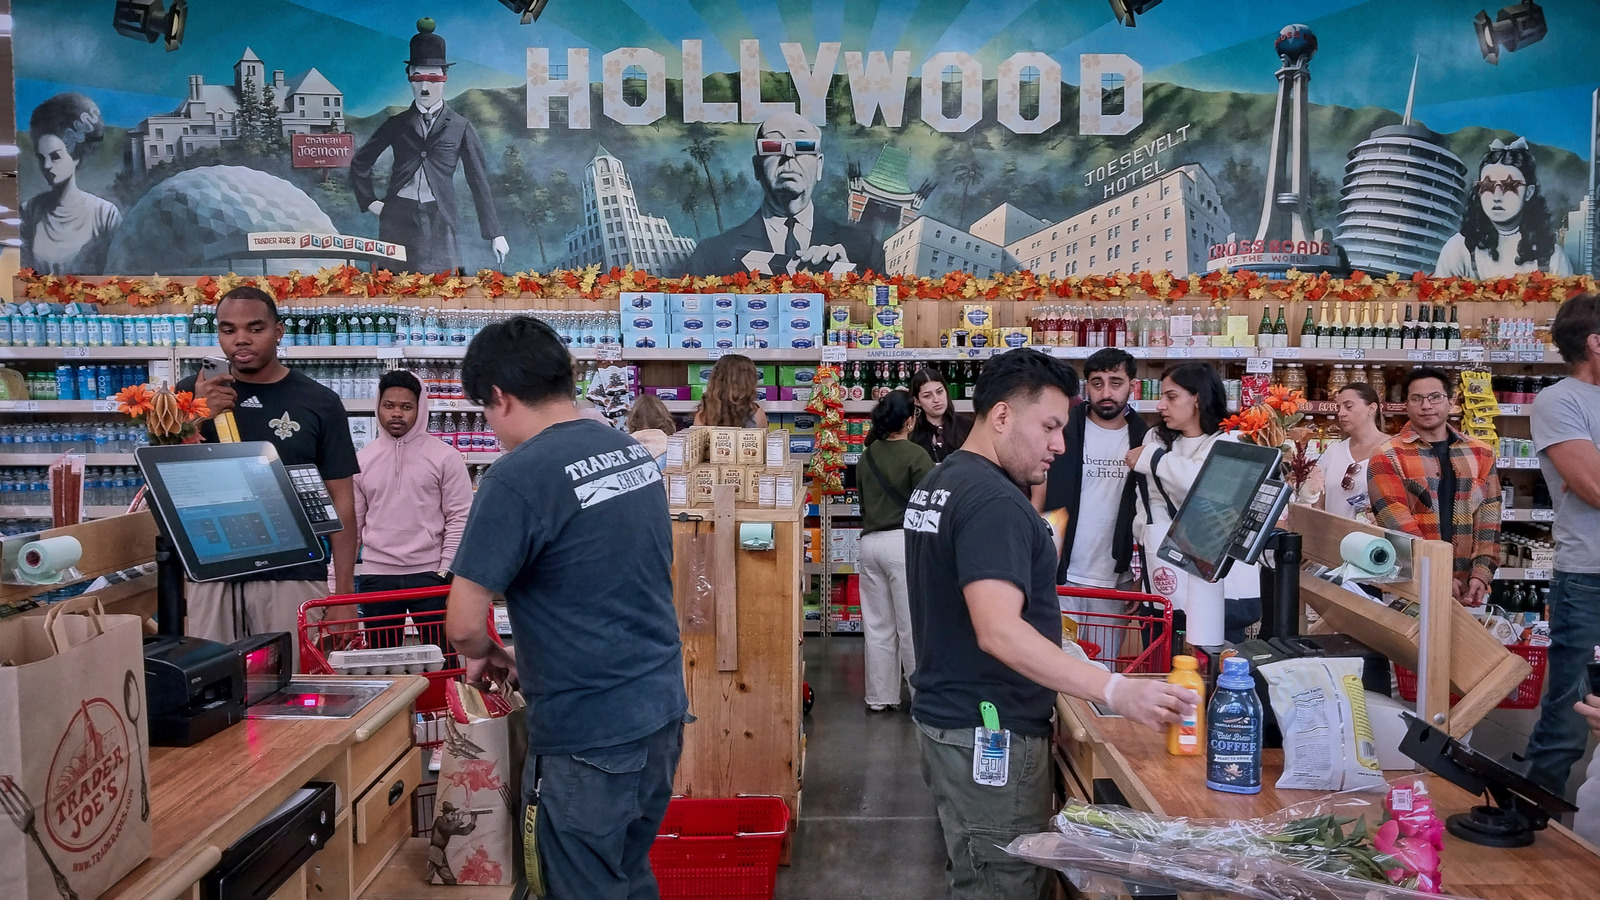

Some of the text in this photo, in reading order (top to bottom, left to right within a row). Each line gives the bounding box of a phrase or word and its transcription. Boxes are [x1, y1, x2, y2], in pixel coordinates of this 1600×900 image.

[526, 40, 1144, 136] HOLLYWOOD
[1084, 124, 1190, 186] JOESEVELT
[1103, 160, 1166, 199] HOTEL
[278, 236, 296, 244] JOE'S
[1208, 240, 1330, 260] CROSS ROADS
[98, 376, 106, 394] ZICO
[564, 449, 630, 480] TRADER
[1083, 454, 1125, 466] bercrom
[616, 468, 648, 490] CREW
[1086, 467, 1124, 478] & Fitch
[1211, 740, 1256, 752] COFFEE
[1217, 732, 1231, 740] Cold
[56, 746, 124, 825] TRADER
[71, 776, 118, 838] JOE'S
